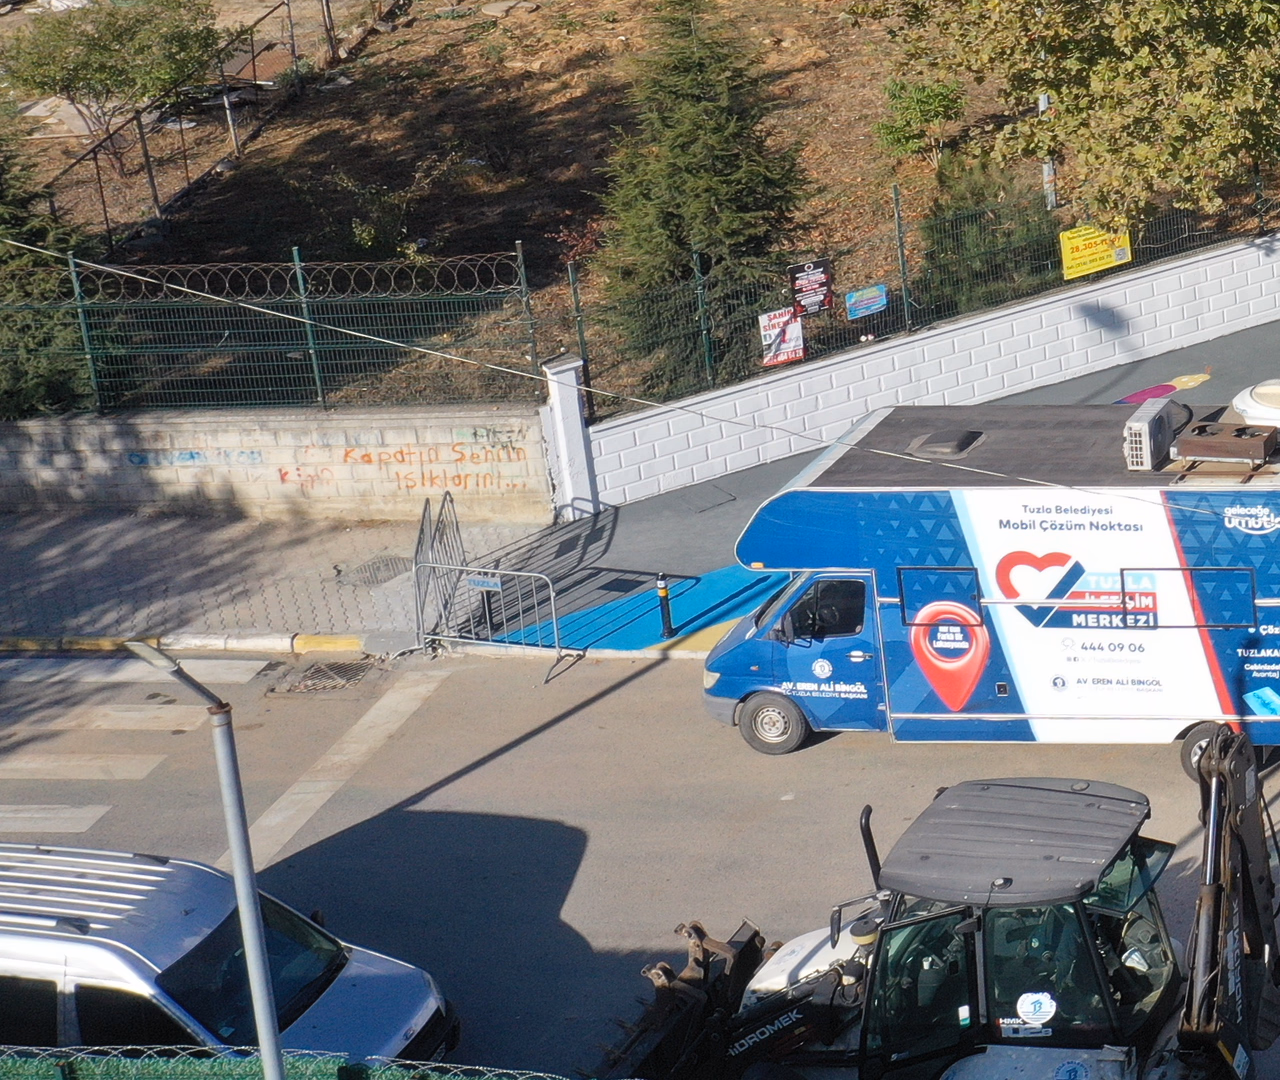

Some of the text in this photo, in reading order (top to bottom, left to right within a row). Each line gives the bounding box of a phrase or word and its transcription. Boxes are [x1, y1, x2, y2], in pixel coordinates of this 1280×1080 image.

[1022, 504, 1113, 517] Tuzla Belediyesi
[1224, 505, 1270, 519] geleceğe
[998, 519, 1143, 532] Mobil Çözüm Noktası
[467, 578, 500, 589] TUZLA
[1086, 575, 1153, 590] TUZLA
[1072, 613, 1154, 628] MERKEZİ
[1081, 642, 1146, 653] 444 09 06
[796, 682, 818, 691] EREN
[819, 680, 834, 692] ALİ
[834, 681, 867, 693] BİNGÖL
[1115, 676, 1129, 686] ALİ
